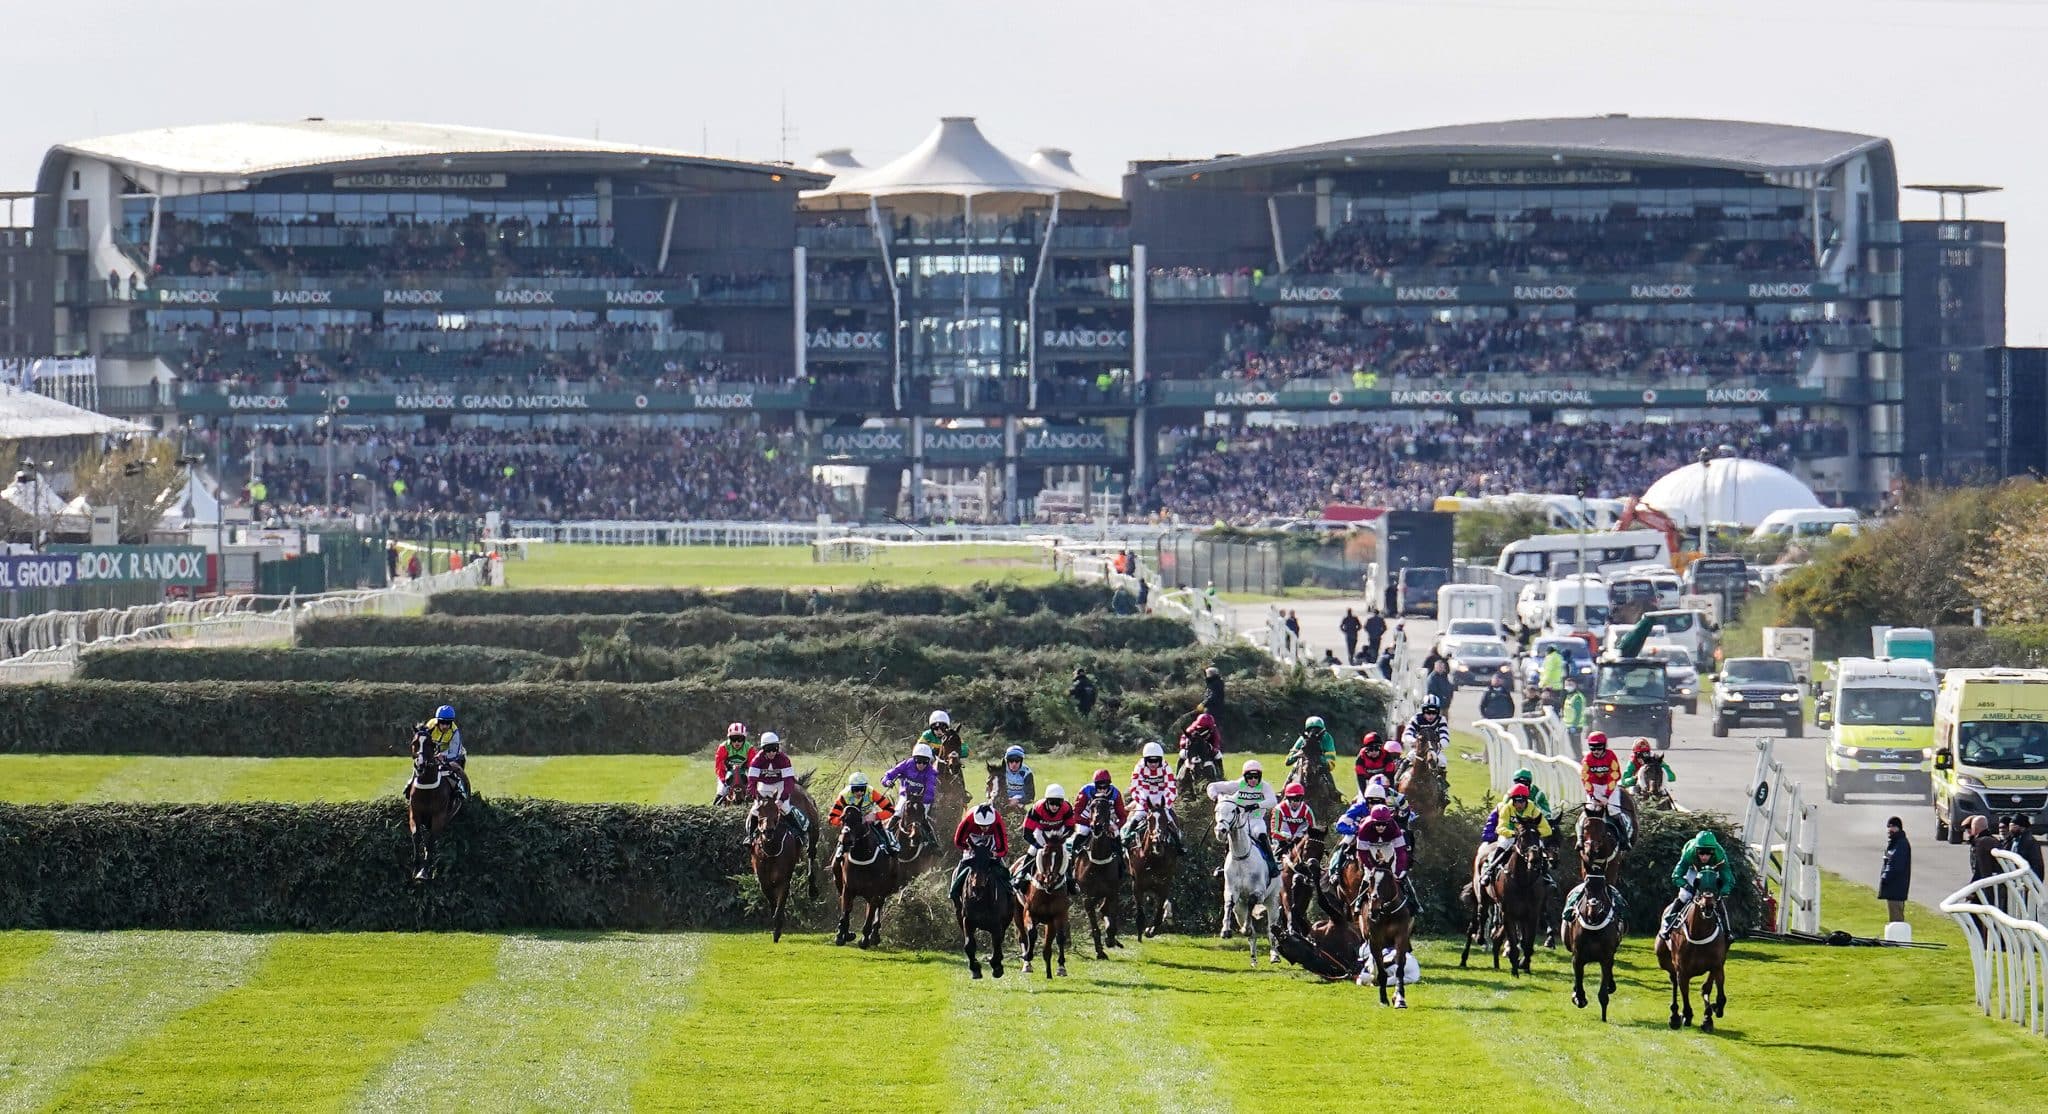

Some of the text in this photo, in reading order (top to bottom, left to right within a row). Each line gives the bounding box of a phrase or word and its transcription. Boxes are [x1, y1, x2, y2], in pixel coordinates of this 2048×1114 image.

[160, 289, 220, 303] RANDOX
[272, 290, 331, 303] RANDOX
[383, 290, 443, 303] RANDOX
[495, 290, 554, 303] RANDOX
[606, 290, 664, 303] RANDOX
[1280, 287, 1343, 300] RANDOX
[1396, 286, 1459, 300] RANDOX
[1514, 286, 1577, 299] RANDOX
[1631, 284, 1693, 298] RANDOX
[1749, 283, 1810, 297] RANDOX
[1044, 330, 1127, 347] RANDOX
[228, 395, 288, 408] RANDOX
[396, 395, 589, 408] RANDOX GRAND NATIONAL
[695, 394, 753, 408] RANDOX
[1215, 392, 1278, 406] RANDOX
[1391, 390, 1592, 404] RANDOX GRAND NATIONAL
[1706, 388, 1769, 402] RANDOX
[822, 433, 902, 449] RANDOX
[924, 433, 1003, 448] RANDOX
[1025, 432, 1104, 448] RANDOX
[130, 552, 202, 579] RANDOX
[17, 560, 73, 587] GROUP
[1982, 712, 2043, 720] AMBULANCE
[1758, 787, 1766, 799] 5
